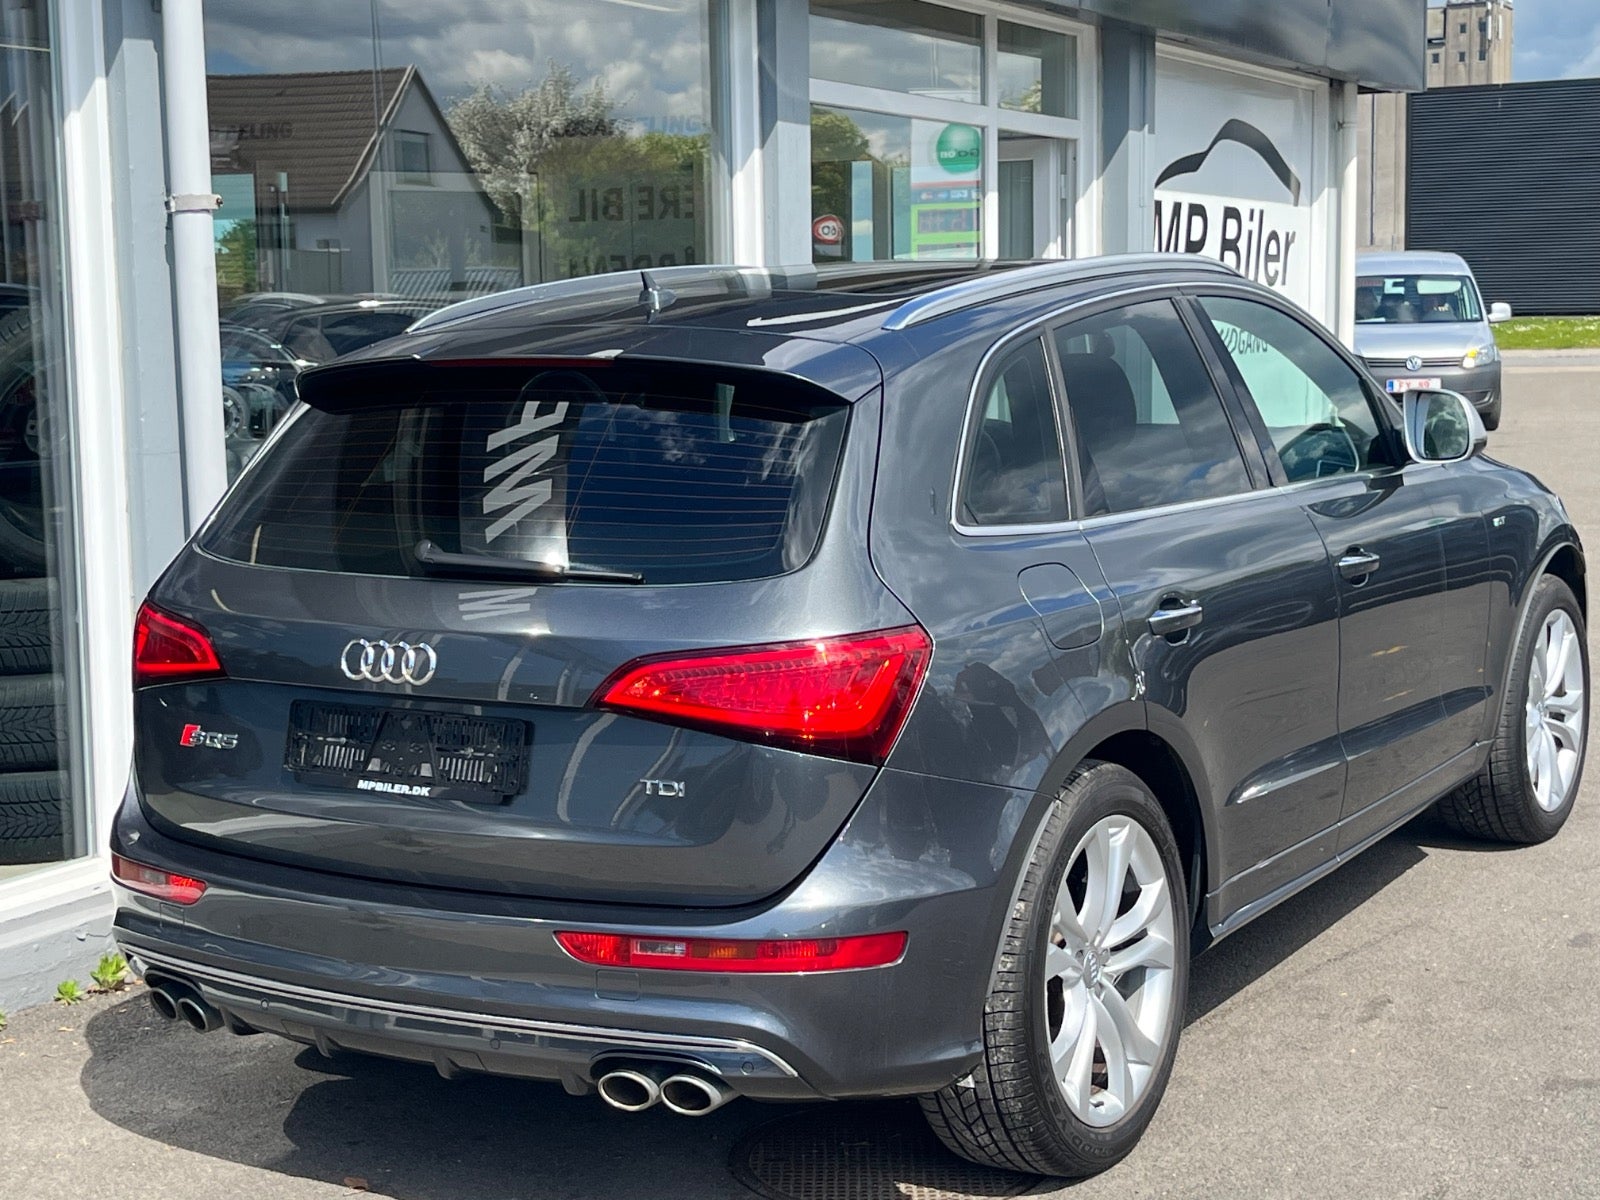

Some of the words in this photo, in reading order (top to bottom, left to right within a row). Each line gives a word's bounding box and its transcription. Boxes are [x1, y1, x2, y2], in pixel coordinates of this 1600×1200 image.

[1154, 199, 1208, 253] MP
[1219, 205, 1296, 287] Biler
[184, 726, 239, 749] SQ5
[357, 779, 431, 797] MPBILER.DK
[640, 779, 686, 797] TDI
